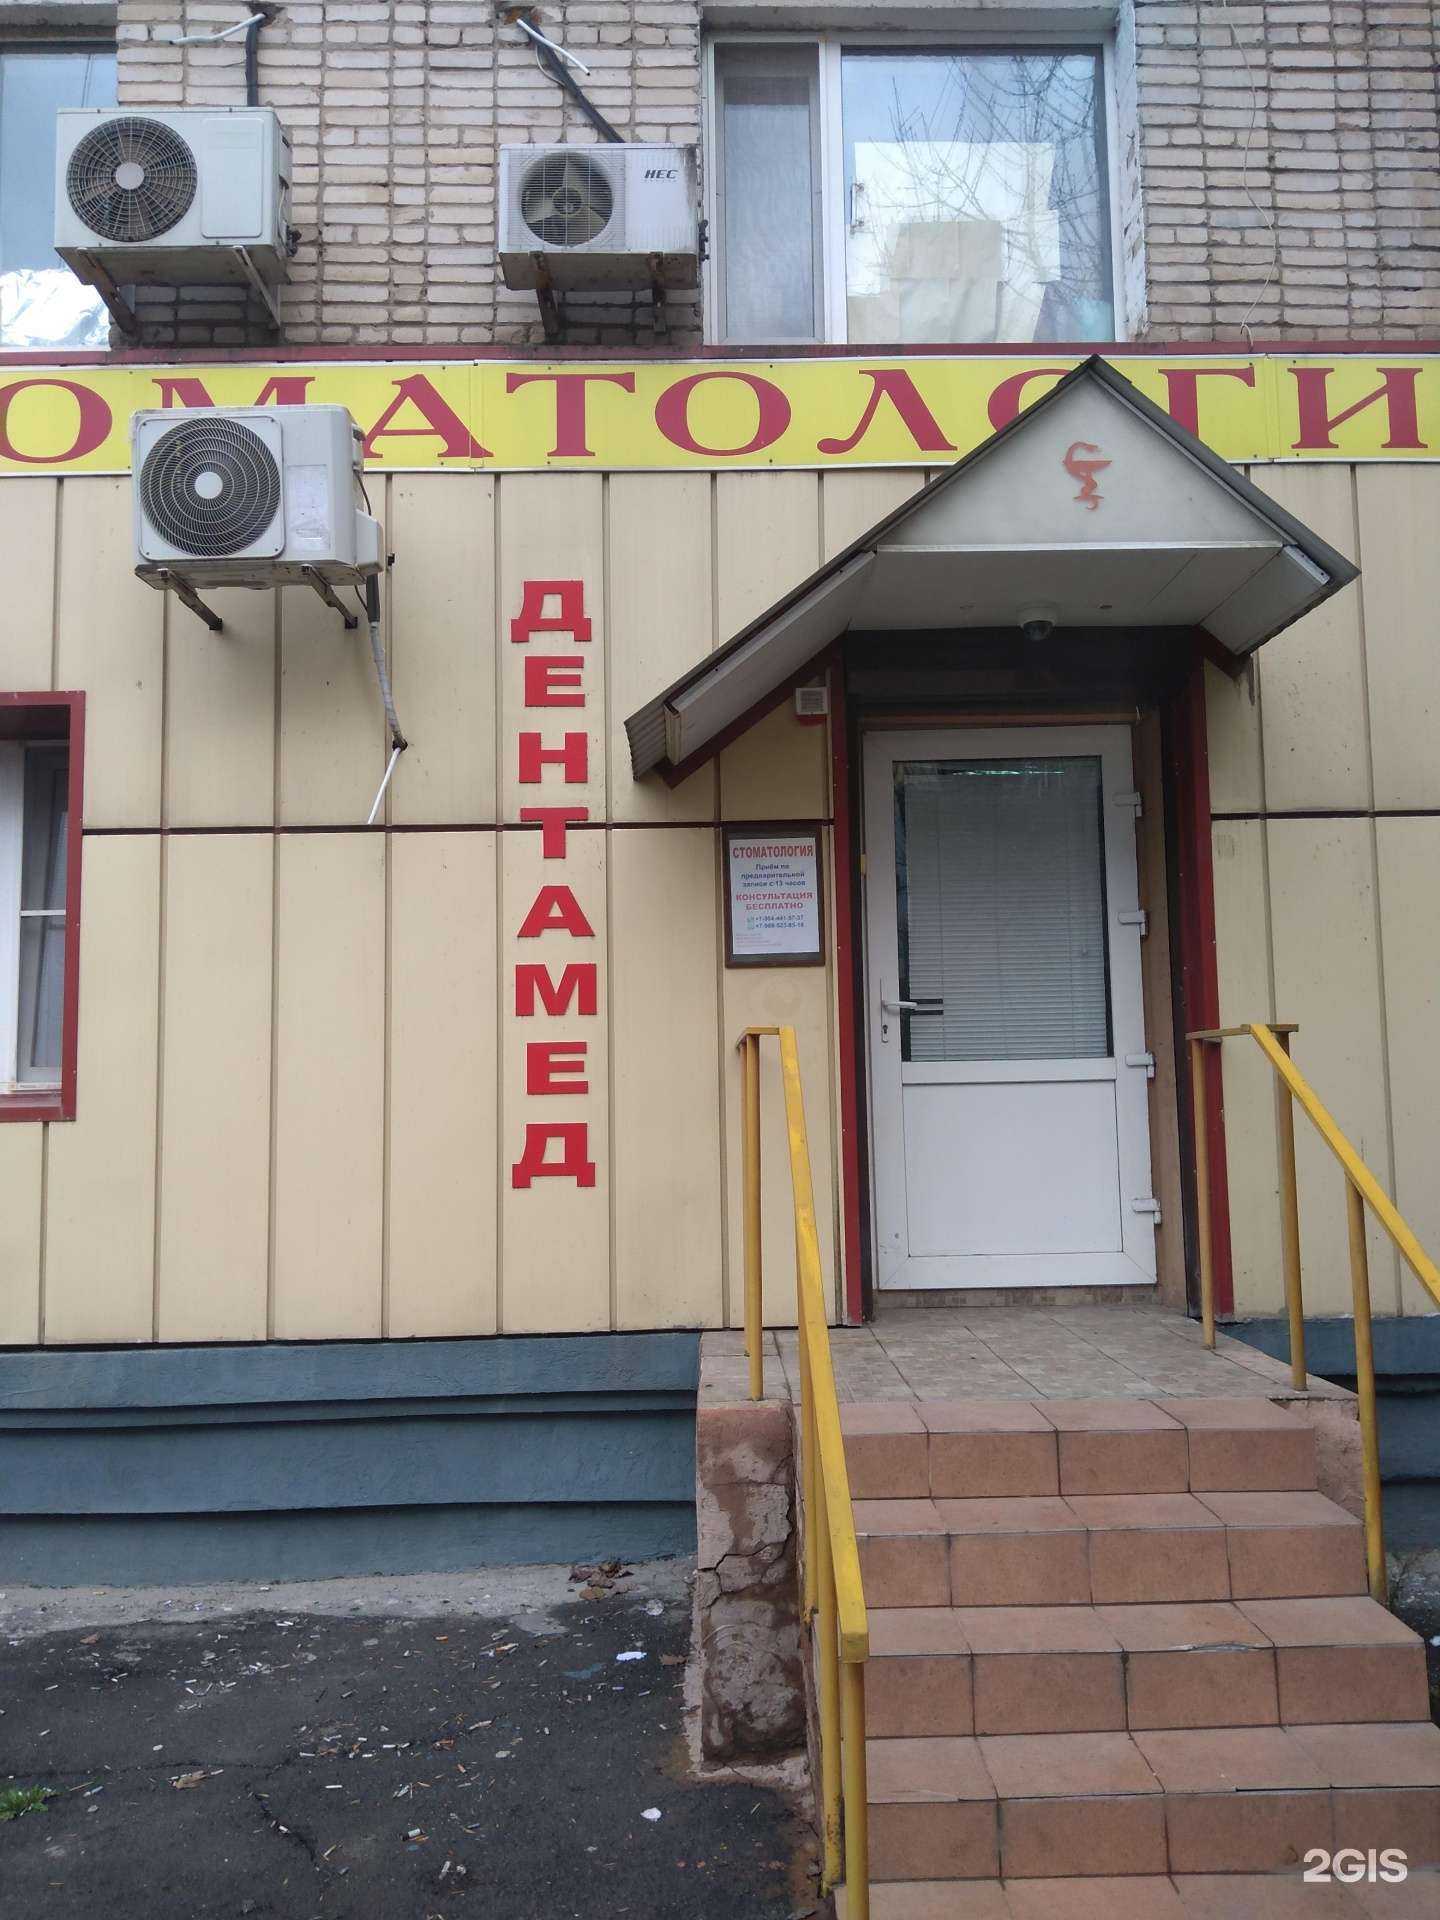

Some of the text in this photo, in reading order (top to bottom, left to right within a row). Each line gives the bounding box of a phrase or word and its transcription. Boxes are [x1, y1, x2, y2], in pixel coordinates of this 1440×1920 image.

[644, 169, 679, 179] HEC
[732, 845, 814, 859] СТОМАТОЛОГИЯ
[741, 871, 805, 880] предварительной
[510, 579, 598, 1189] ДЕНТАМЕД
[735, 892, 813, 901] КОНСУЛЬТАЦИЯ
[746, 902, 803, 910] БЕСПЛАТНО
